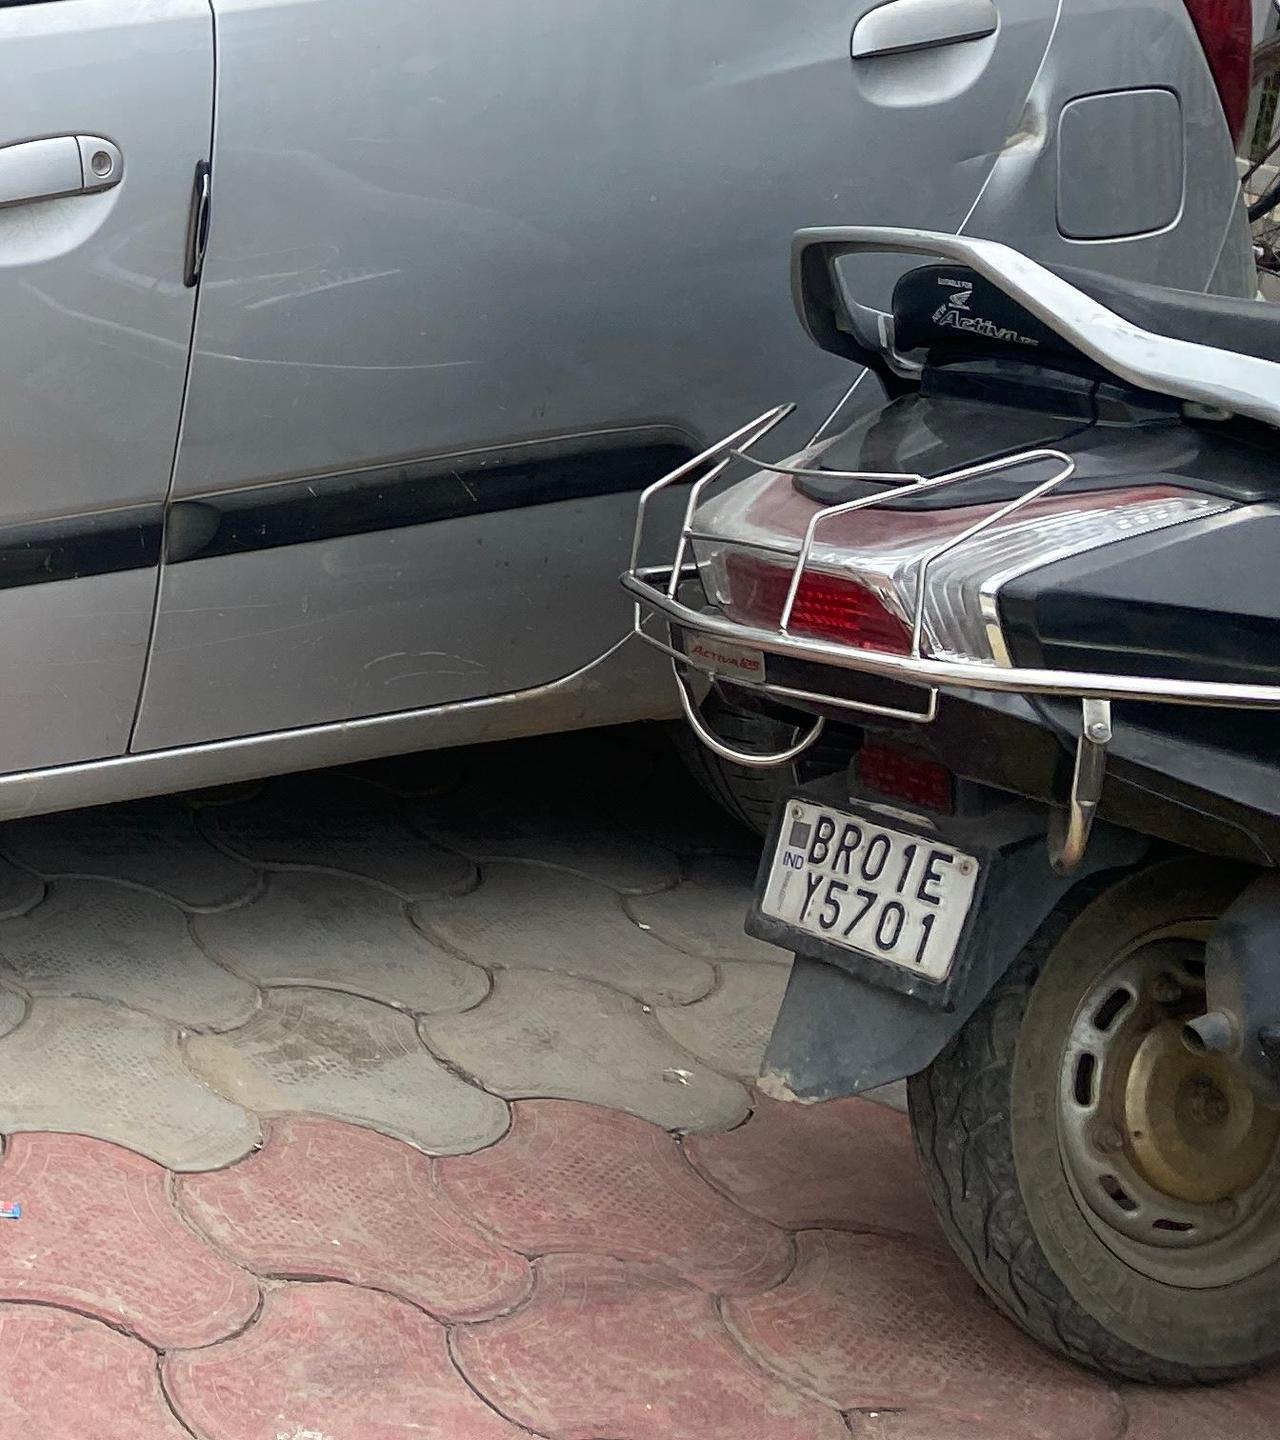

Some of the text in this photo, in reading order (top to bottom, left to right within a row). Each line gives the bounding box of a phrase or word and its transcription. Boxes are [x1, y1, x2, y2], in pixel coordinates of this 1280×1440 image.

[940, 310, 1018, 340] Activa
[783, 851, 804, 870] IND
[808, 816, 954, 905] BR01E
[798, 872, 937, 963] Y5701
